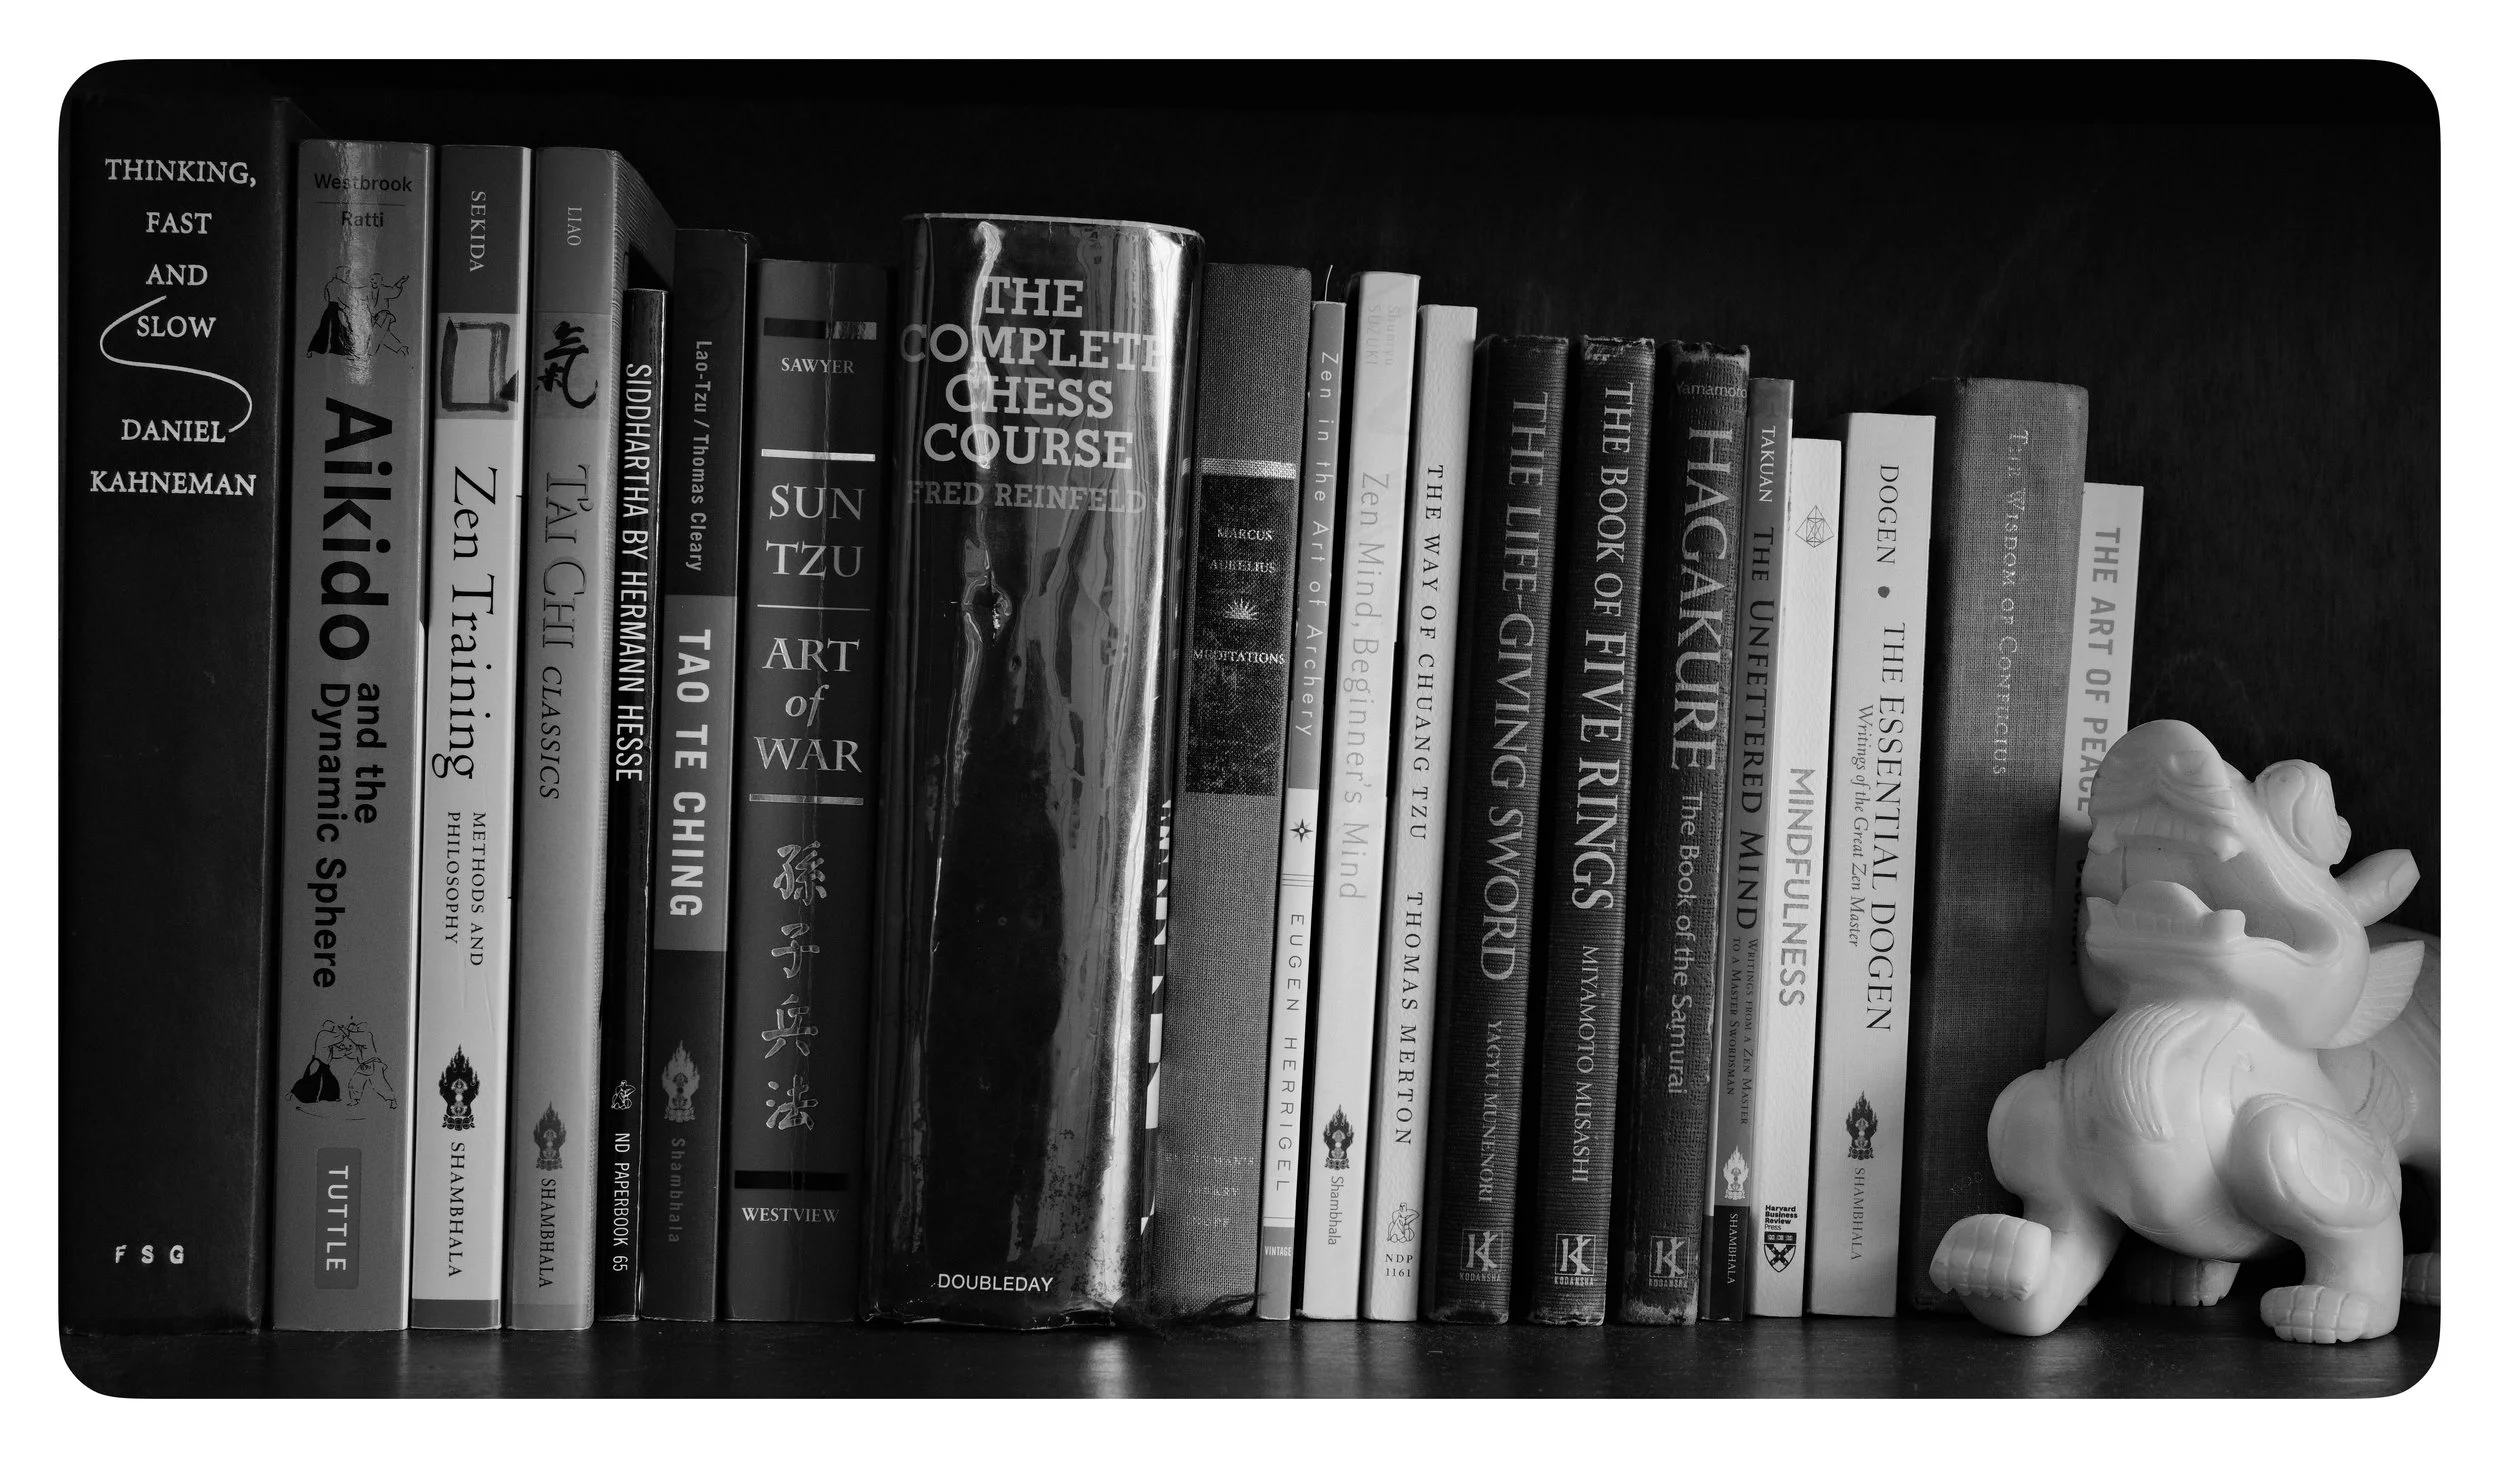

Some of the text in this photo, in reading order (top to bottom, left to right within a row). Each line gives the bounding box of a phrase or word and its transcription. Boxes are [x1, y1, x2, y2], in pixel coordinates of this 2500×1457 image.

[105, 158, 257, 189] THINKING,
[314, 173, 412, 193] Westbrook
[145, 212, 212, 234] FAST
[341, 210, 384, 228] Ratti
[469, 191, 486, 272] SEKIDA
[567, 207, 581, 247] LIAO
[145, 264, 208, 286] AND
[984, 276, 1084, 318] THE
[136, 316, 216, 338] SLOW
[694, 340, 713, 415] Lao-Tzu
[781, 357, 855, 375] SAWYER
[945, 373, 1114, 419] CHESS
[1676, 382, 1748, 399] Yamamoto
[121, 419, 226, 442] DANIEL
[923, 423, 1133, 469] COURSE
[1758, 425, 1776, 503] TAKUAN
[90, 470, 256, 497] KAHNEMAN
[691, 435, 711, 504] Thomas
[769, 483, 866, 521] SUN
[907, 480, 984, 506] FRED
[994, 482, 1147, 514] REINFELD
[319, 397, 393, 661] Aikido
[685, 512, 709, 573] Cleary
[1217, 528, 1273, 541] MARCUS
[1295, 351, 1340, 737] Zen in the Art of Archery
[1877, 464, 1900, 565] DOGEN
[2002, 487, 2026, 587] WISDOM
[615, 363, 652, 782] SIDDHARTHA BY HERMANN HESSE
[766, 540, 864, 577] TZU
[1209, 559, 1276, 573] AURELIUS
[2093, 526, 2121, 585] THE
[432, 466, 497, 780] Zen Training
[540, 556, 585, 650] CHI
[1671, 427, 1734, 771] HAGAKURE
[2088, 596, 2117, 656] ART
[762, 637, 860, 673] ART
[1193, 649, 1285, 665] MEDITATIONS
[1410, 465, 1444, 841] THE WAY OF CHUANG TZU
[1571, 382, 1635, 912] THE BOOK OF FIVE RINGS
[786, 684, 830, 727] of
[1339, 473, 1390, 900] Zen Mind, Beginner's Mind
[1480, 392, 1548, 982] THE LIFE-GIVING SWORD
[2085, 667, 2112, 704] OF
[355, 683, 387, 824] and the
[541, 666, 562, 800] CLASSICS
[754, 736, 862, 773] WAR
[1736, 527, 1775, 931] THE UNFETTERED MIND
[669, 629, 711, 918] TAO TE CHING
[307, 683, 350, 988] Dynamic Sphere
[1848, 704, 1874, 949] Writings of the Great Zen Master
[1866, 622, 1906, 1032] THE ESSENTIAL DOGEN
[445, 812, 460, 944] PHILOSOPHY
[470, 812, 487, 966] METHODS AND
[1778, 769, 1817, 1008] MINDFULNESS
[1667, 791, 1703, 1094] The Book of the Samurai
[1275, 914, 1304, 1192] EUGEN HERRIGEL
[1395, 892, 1423, 1145] THOMAS MERTON
[1571, 945, 1600, 1184] MIYAMOTO MUSASHI
[1478, 1020, 1503, 1204] YAGYU MUNENORI
[325, 1166, 349, 1272] TUTTLE
[448, 1143, 465, 1277] SHAMBHALA
[612, 1132, 630, 1272] ND PAPERBOOK 65
[668, 1138, 687, 1244] Shambhala
[742, 1206, 840, 1224] WESTVIEW
[1328, 1176, 1344, 1246] Shambhala
[1764, 1211, 1798, 1219] Business
[1765, 1204, 1797, 1212] Harvard
[1850, 1166, 1867, 1262] SHAMBHALA
[539, 1178, 553, 1289] SHAMBHALA
[1264, 1245, 1292, 1258] VINTAGE
[1385, 1253, 1414, 1263] NDP
[1726, 1213, 1739, 1285] SHAMBHALA
[938, 1273, 1054, 1293] DOUBLEDAY
[1385, 1268, 1412, 1278] 1161
[1459, 1272, 1501, 1283] KODANSHA
[1554, 1276, 1595, 1286] KODANSHA
